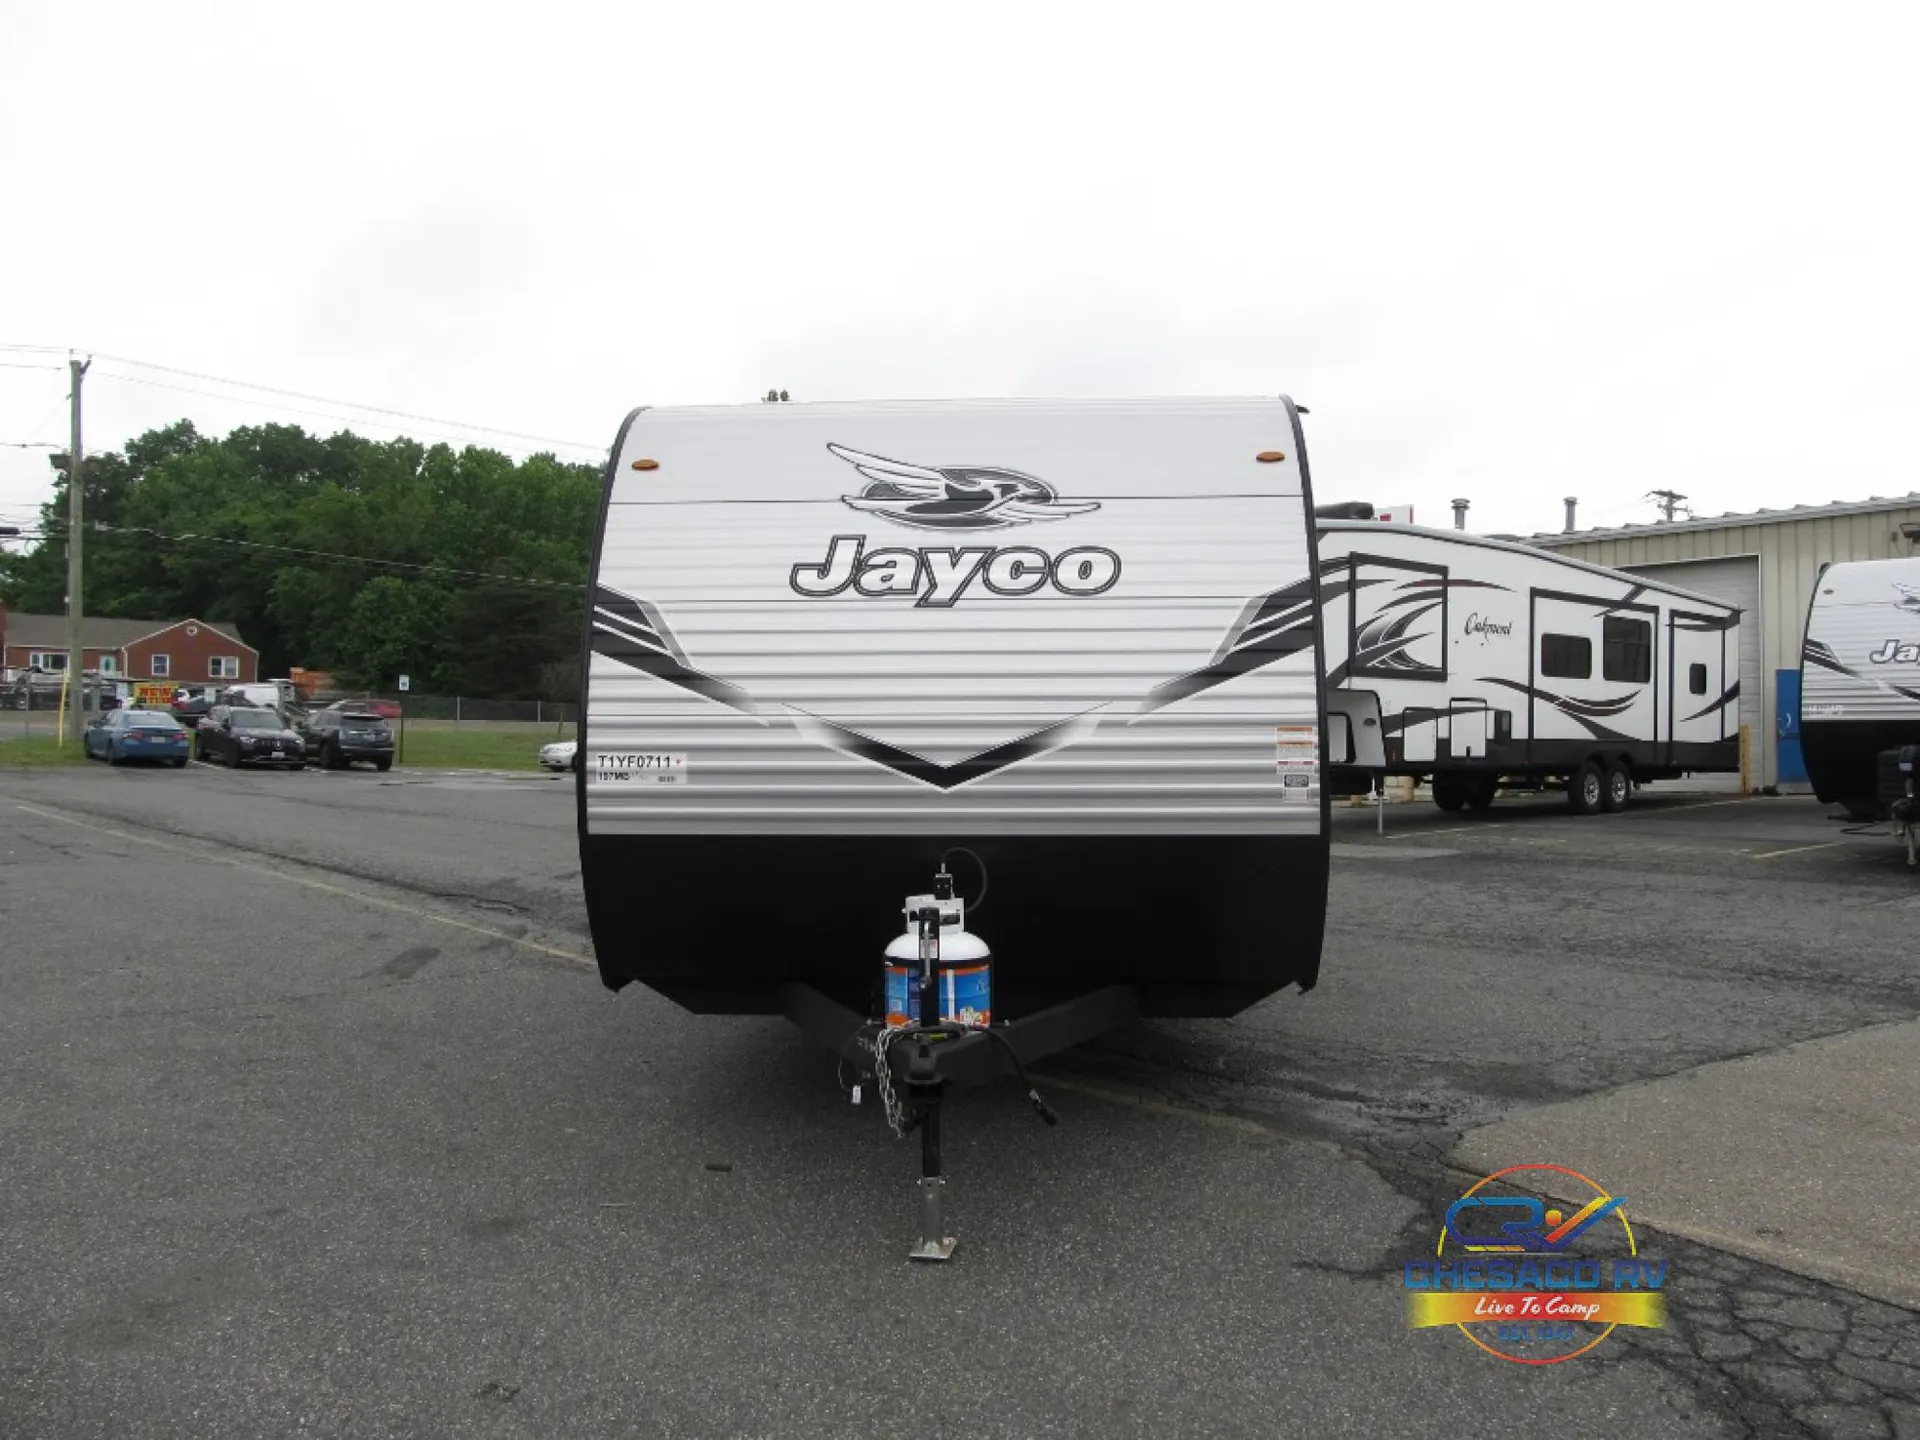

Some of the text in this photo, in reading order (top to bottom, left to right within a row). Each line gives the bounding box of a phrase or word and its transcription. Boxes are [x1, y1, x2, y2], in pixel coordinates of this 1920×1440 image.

[789, 534, 1122, 608] Jayco
[1869, 639, 1920, 666] Ja
[597, 755, 670, 768] T1YF0711
